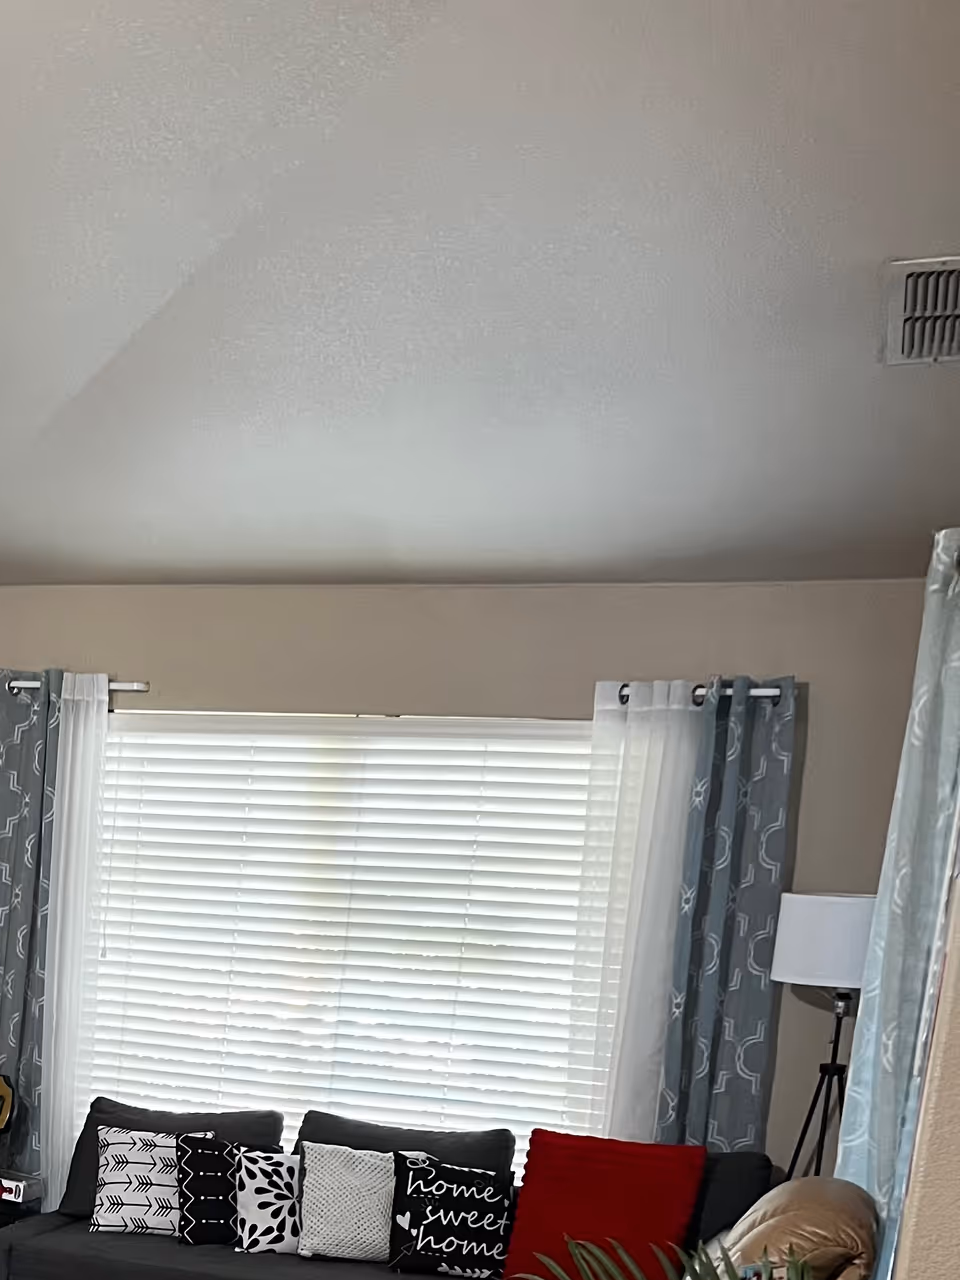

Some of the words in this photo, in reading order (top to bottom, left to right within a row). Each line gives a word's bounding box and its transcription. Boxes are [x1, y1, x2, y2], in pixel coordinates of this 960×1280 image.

[407, 1170, 502, 1202] home
[422, 1205, 510, 1235] sweet
[417, 1225, 508, 1259] home
